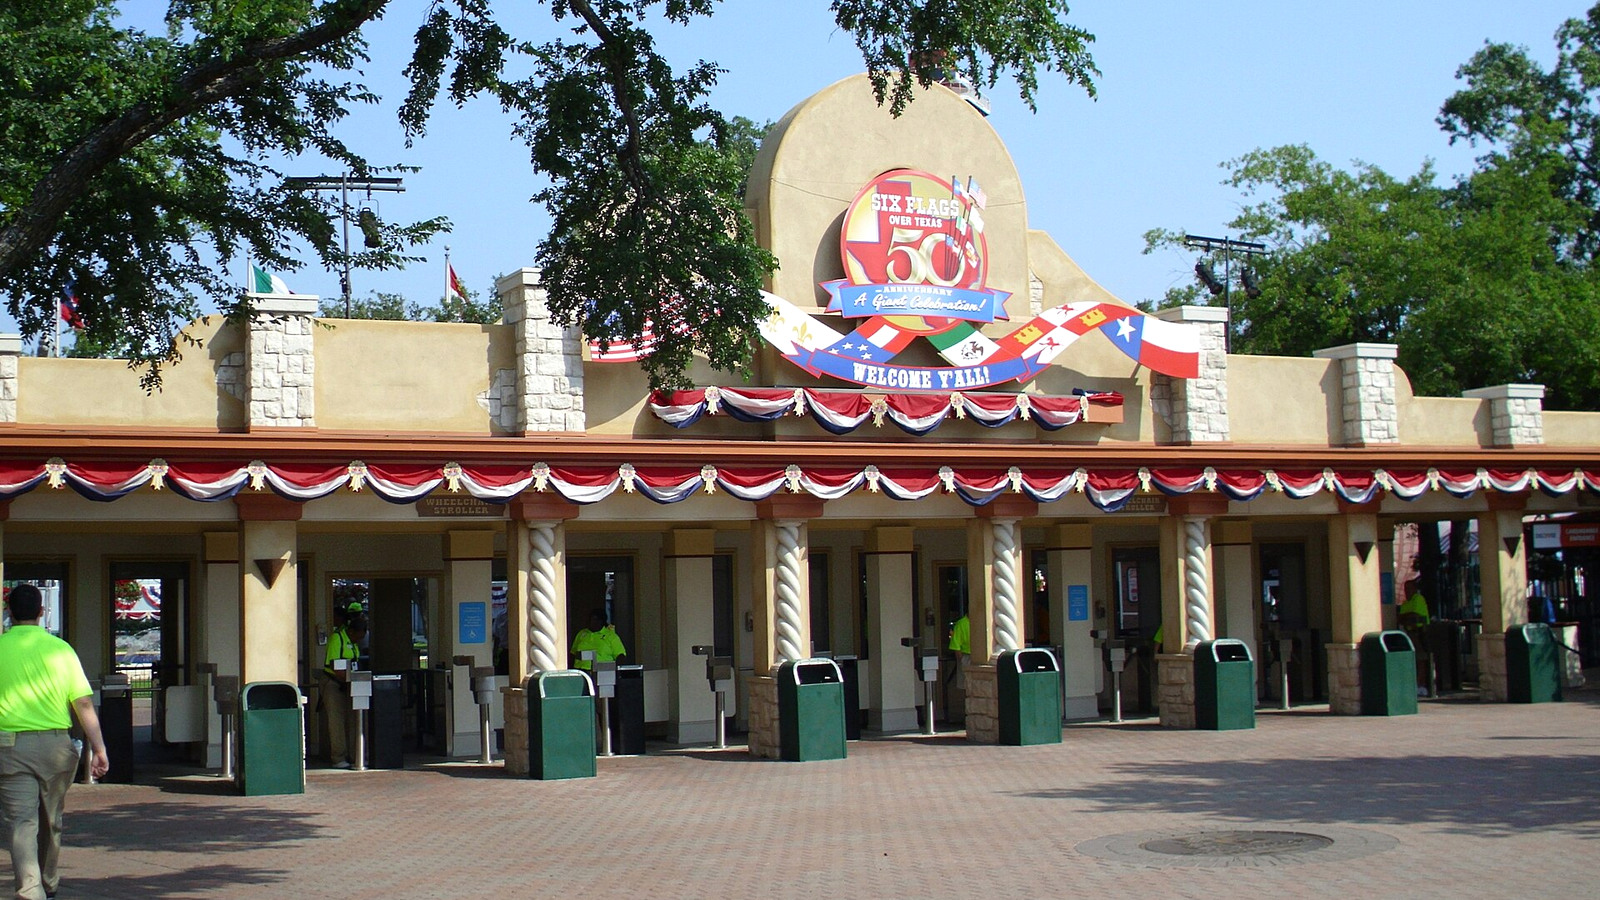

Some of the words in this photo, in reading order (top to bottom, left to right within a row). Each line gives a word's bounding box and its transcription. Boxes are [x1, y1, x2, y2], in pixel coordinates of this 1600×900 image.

[871, 193, 902, 213] SIX
[905, 196, 960, 217] FLAGS
[889, 215, 912, 226] OVER
[914, 217, 942, 228] TEXAS
[885, 227, 966, 288] 50
[883, 286, 953, 296] ANNIVERSARY
[854, 292, 868, 307] A
[872, 294, 908, 311] Giant
[909, 295, 987, 312] Celebration!
[853, 362, 932, 389] WELCOME
[937, 366, 990, 389] Y'ALL!
[426, 498, 493, 506] WHEELCHA
